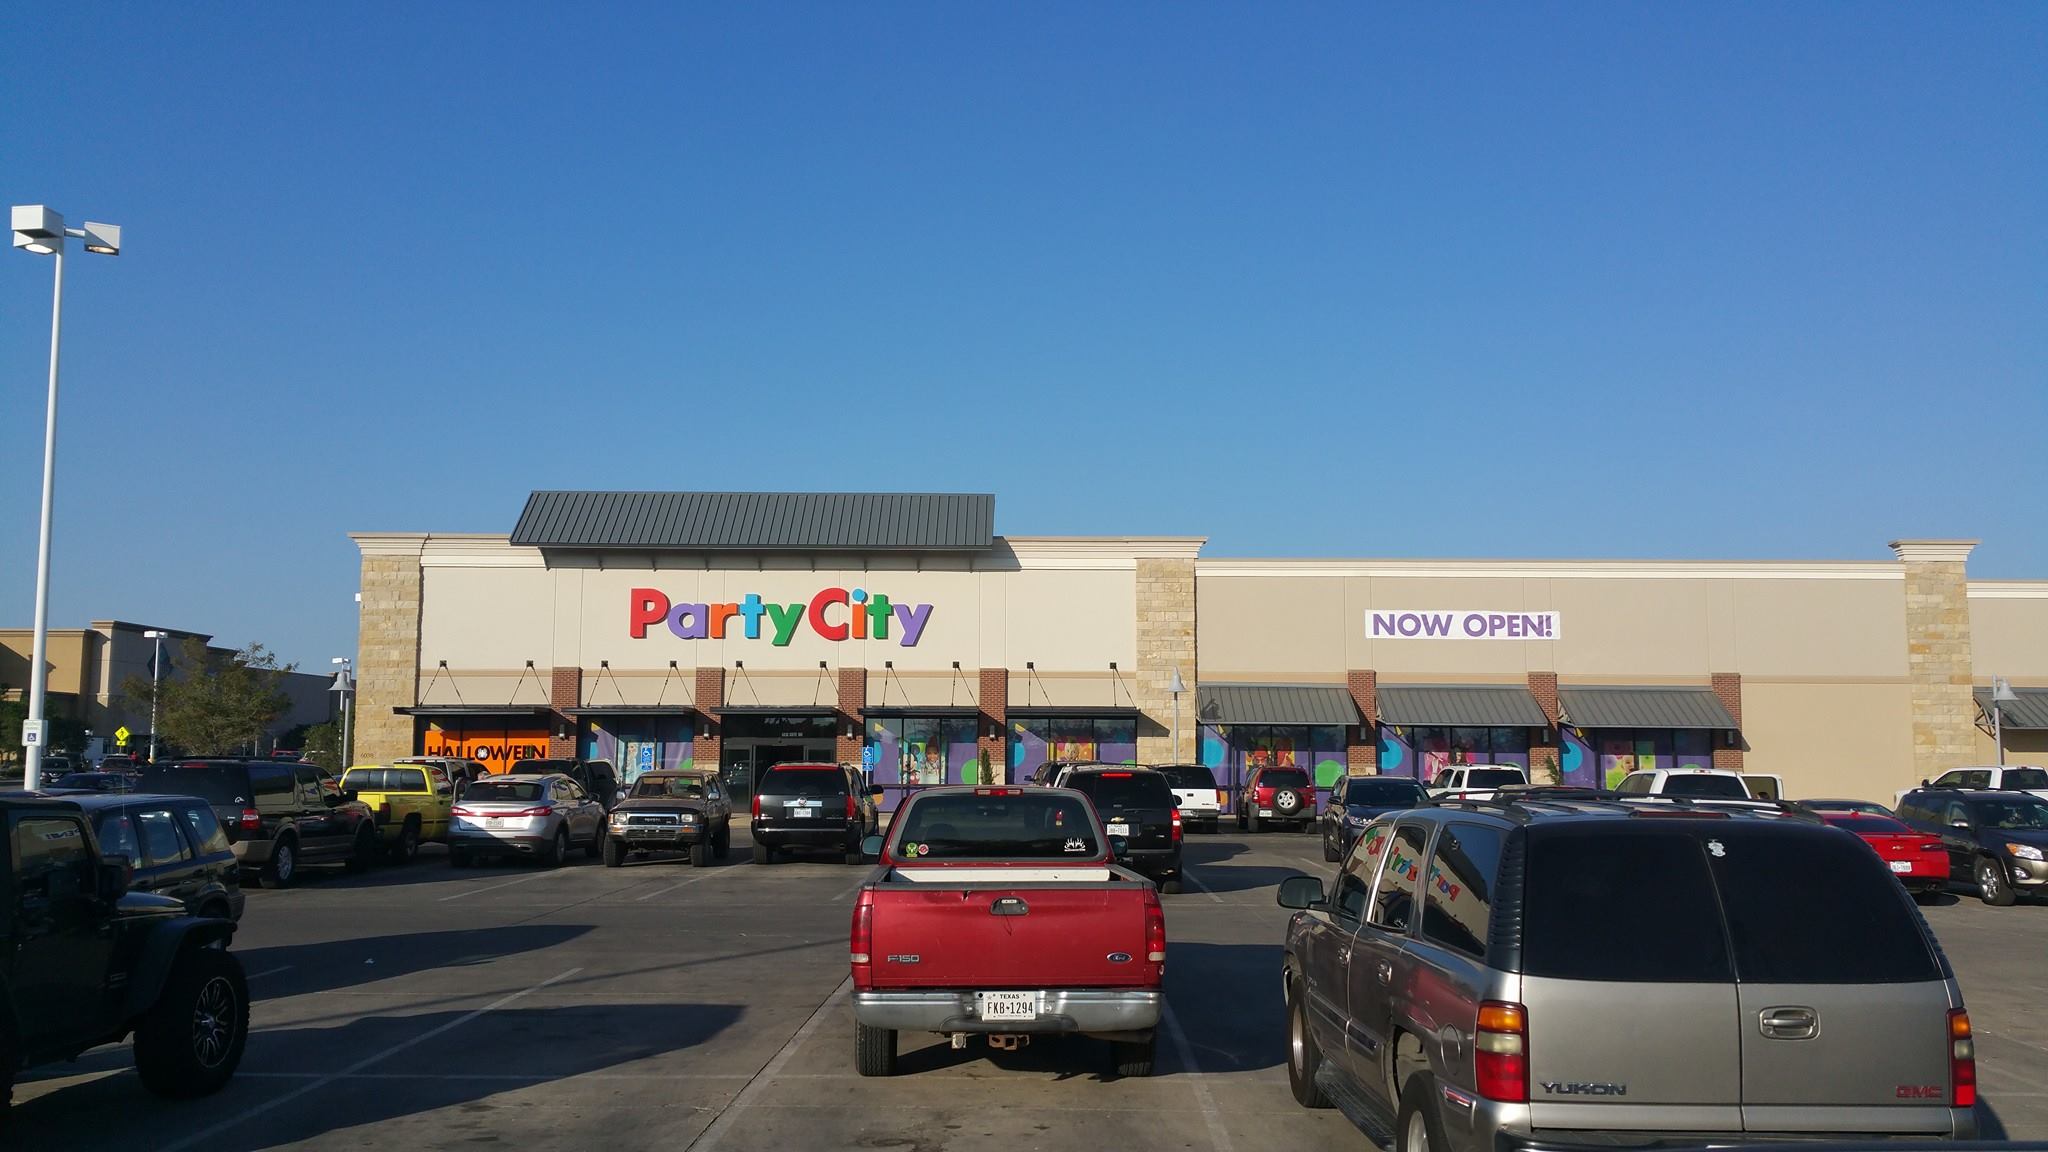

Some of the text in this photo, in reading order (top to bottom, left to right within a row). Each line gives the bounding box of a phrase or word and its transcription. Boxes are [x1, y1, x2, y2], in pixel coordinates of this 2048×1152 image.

[1373, 613, 1553, 637] NOW OPEN!
[1540, 1082, 1627, 1095] YUKON
[1896, 1085, 1942, 1098] GMC
